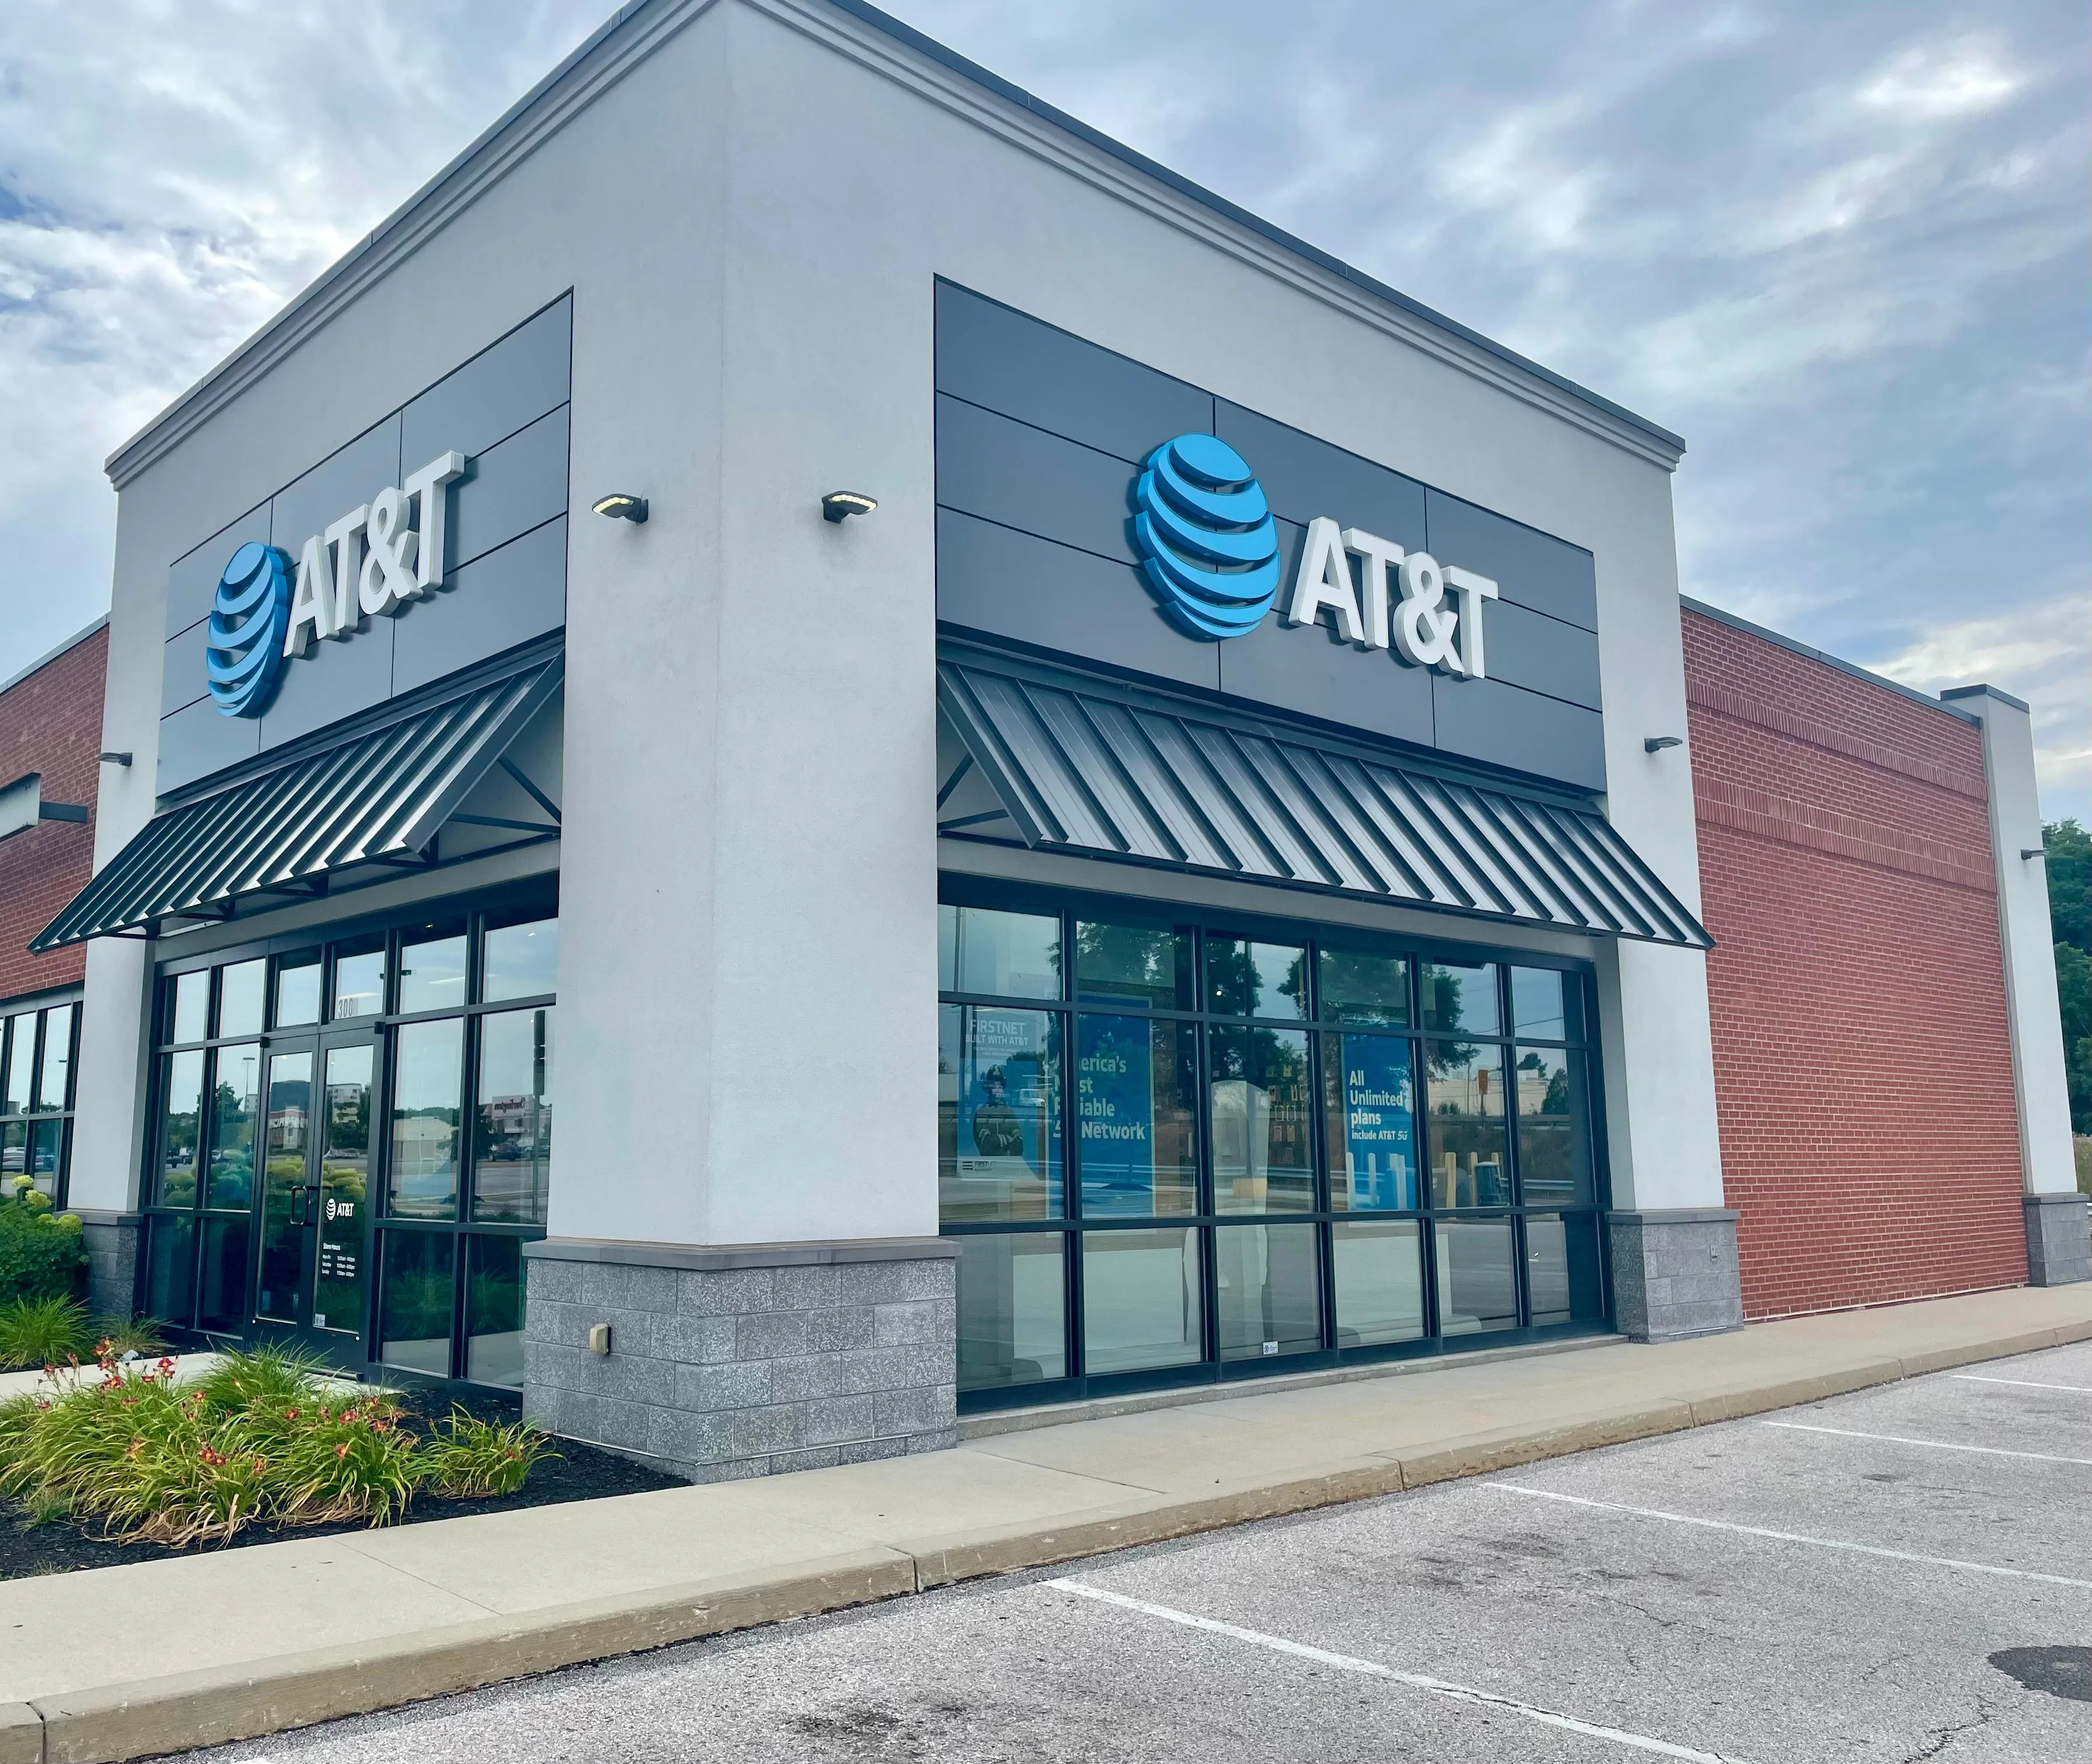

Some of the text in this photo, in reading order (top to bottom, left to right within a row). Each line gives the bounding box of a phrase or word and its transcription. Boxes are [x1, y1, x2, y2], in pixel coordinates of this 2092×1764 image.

[283, 450, 464, 658] AT&T
[1289, 516, 1499, 679] AT&T
[338, 998, 353, 1018] 300
[970, 1019, 1026, 1035] FIRSTNET
[987, 1036, 1007, 1045] WITH
[1009, 1037, 1029, 1046] AT&T
[1349, 1070, 1365, 1086] All
[1350, 1089, 1403, 1107] Unlimited
[1351, 1109, 1382, 1129] plans
[1082, 1121, 1145, 1140] Network
[1352, 1130, 1408, 1140] include AT&T 5G
[336, 1203, 355, 1217] AT&T
